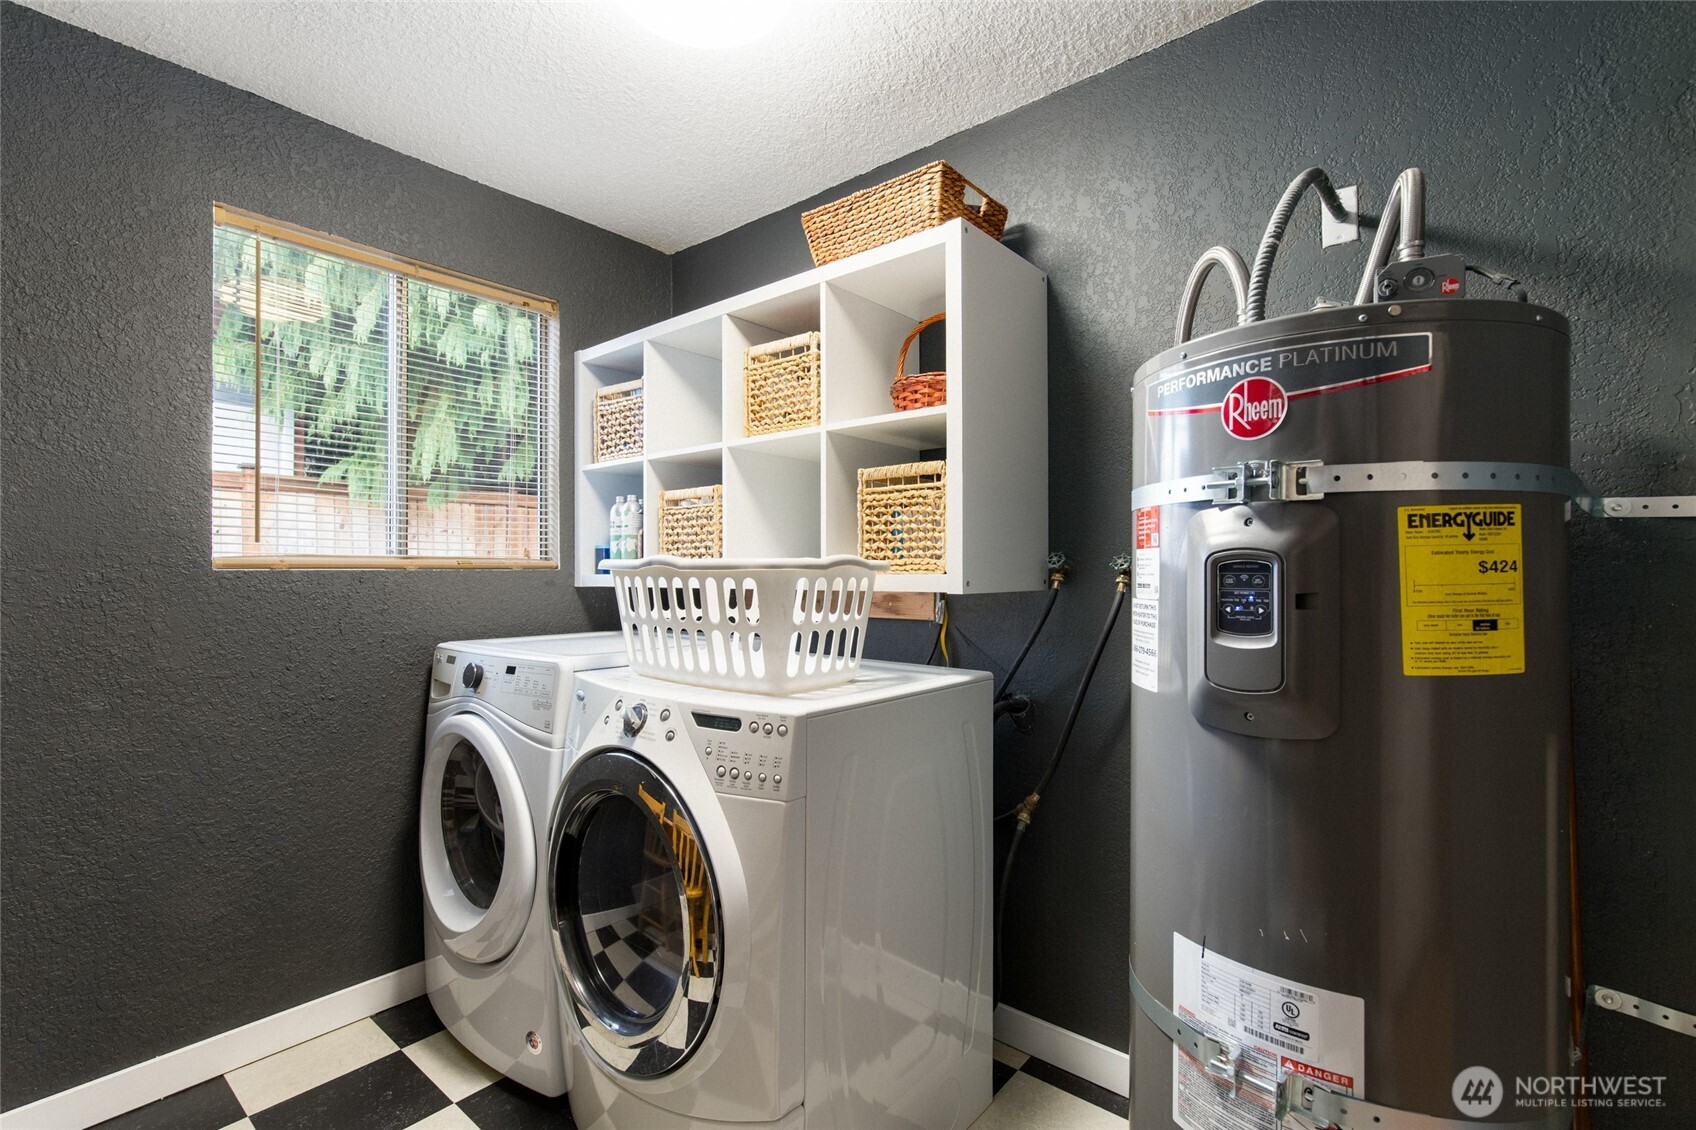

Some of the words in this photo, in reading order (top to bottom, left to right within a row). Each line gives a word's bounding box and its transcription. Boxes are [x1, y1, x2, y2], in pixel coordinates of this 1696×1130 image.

[1157, 356, 1272, 398] PERFORMANCE
[1279, 340, 1398, 369] PLATINUM
[1229, 381, 1283, 430] Rheem
[1407, 511, 1515, 529] ENERGYGUIDE
[1478, 560, 1518, 575] $424
[1286, 1004, 1296, 1016] UL
[1297, 1063, 1349, 1086] DANGER
